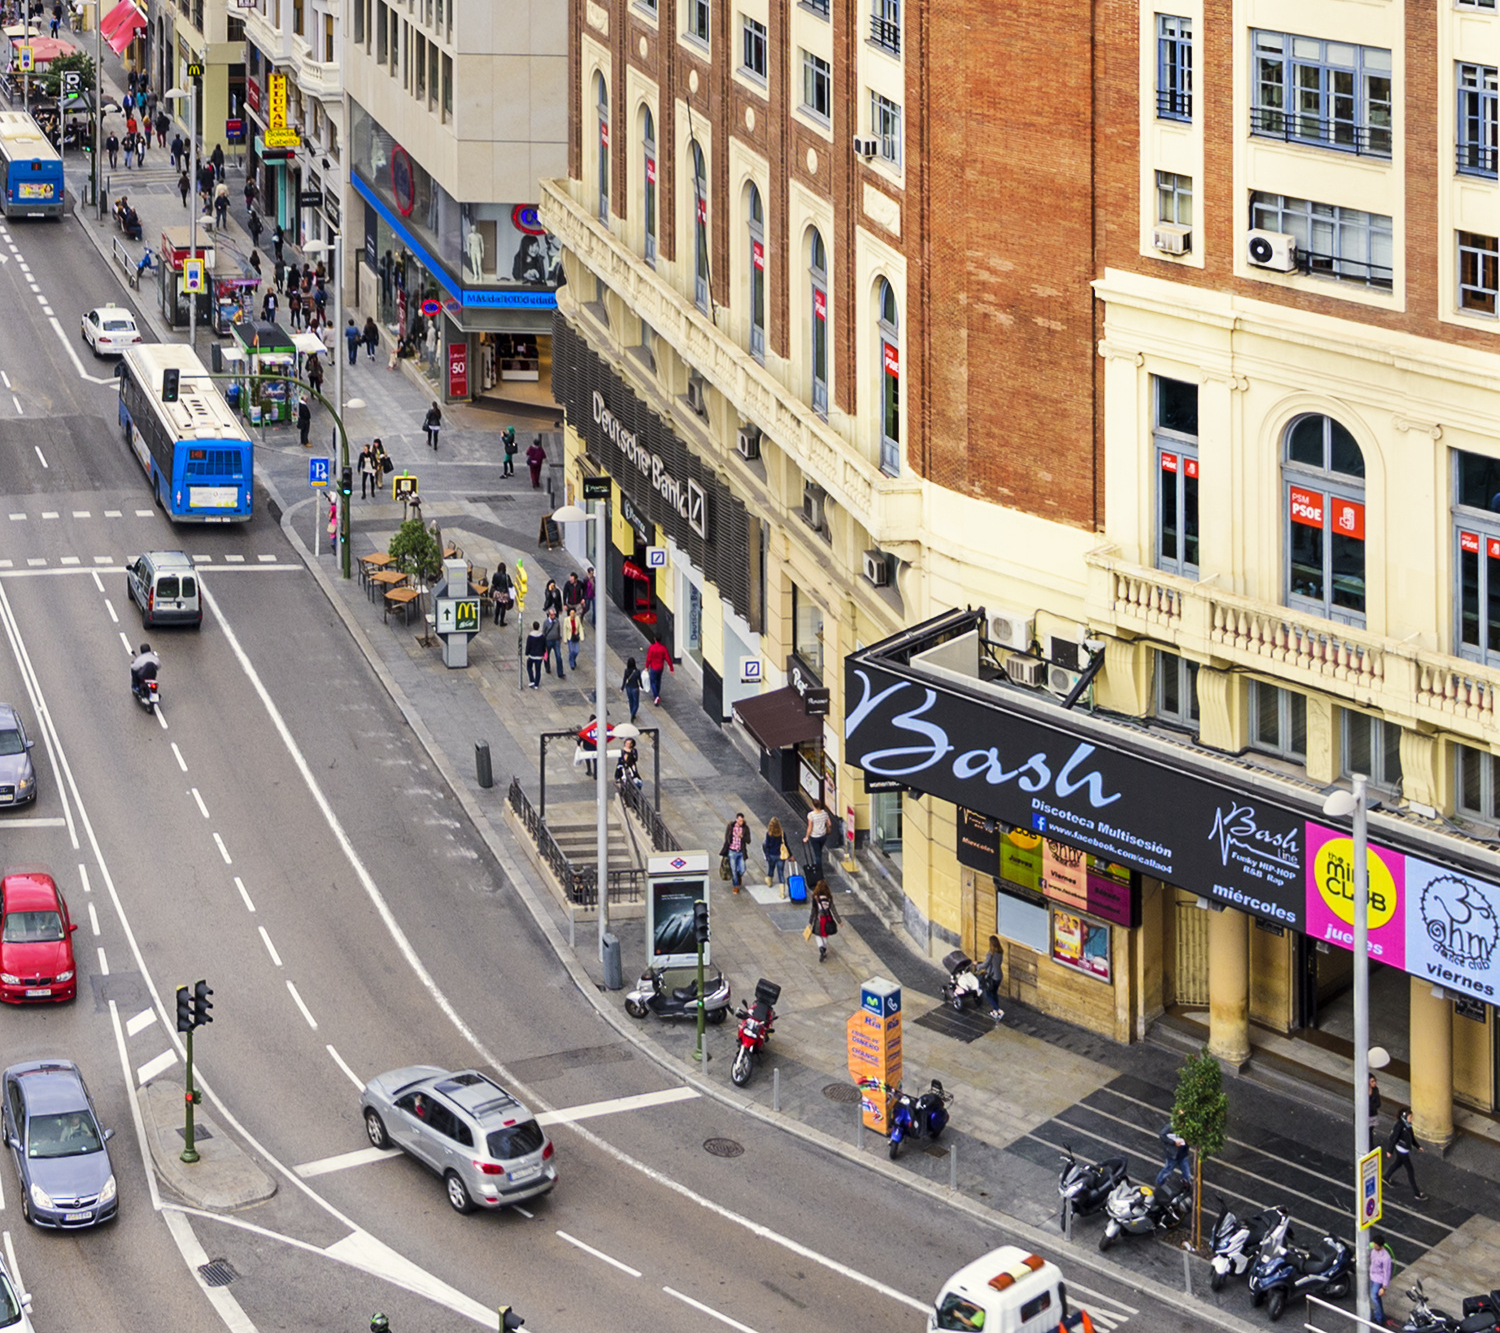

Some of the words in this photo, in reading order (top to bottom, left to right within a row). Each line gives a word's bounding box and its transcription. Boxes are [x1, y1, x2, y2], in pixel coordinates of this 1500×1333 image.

[452, 362, 466, 374] 50
[593, 390, 651, 477] Deutsche
[652, 453, 689, 519] Bank
[1292, 492, 1310, 504] PSM
[1292, 502, 1322, 522] PSOE
[845, 669, 1122, 809] Bash
[1031, 797, 1096, 831] Discoteca
[1097, 821, 1173, 859] Multisesión
[1223, 801, 1300, 854] Bash
[1049, 822, 1173, 875] www.facebook.com/callao4
[1232, 851, 1259, 870] Funky
[1259, 862, 1296, 881] HIP-HOP
[1243, 865, 1263, 879] R&B
[1266, 874, 1285, 887] Rap
[1212, 883, 1296, 924] miércoles
[1325, 924, 1384, 955] juees
[1426, 962, 1495, 997] viernes
[851, 1047, 880, 1063] CHANGE
